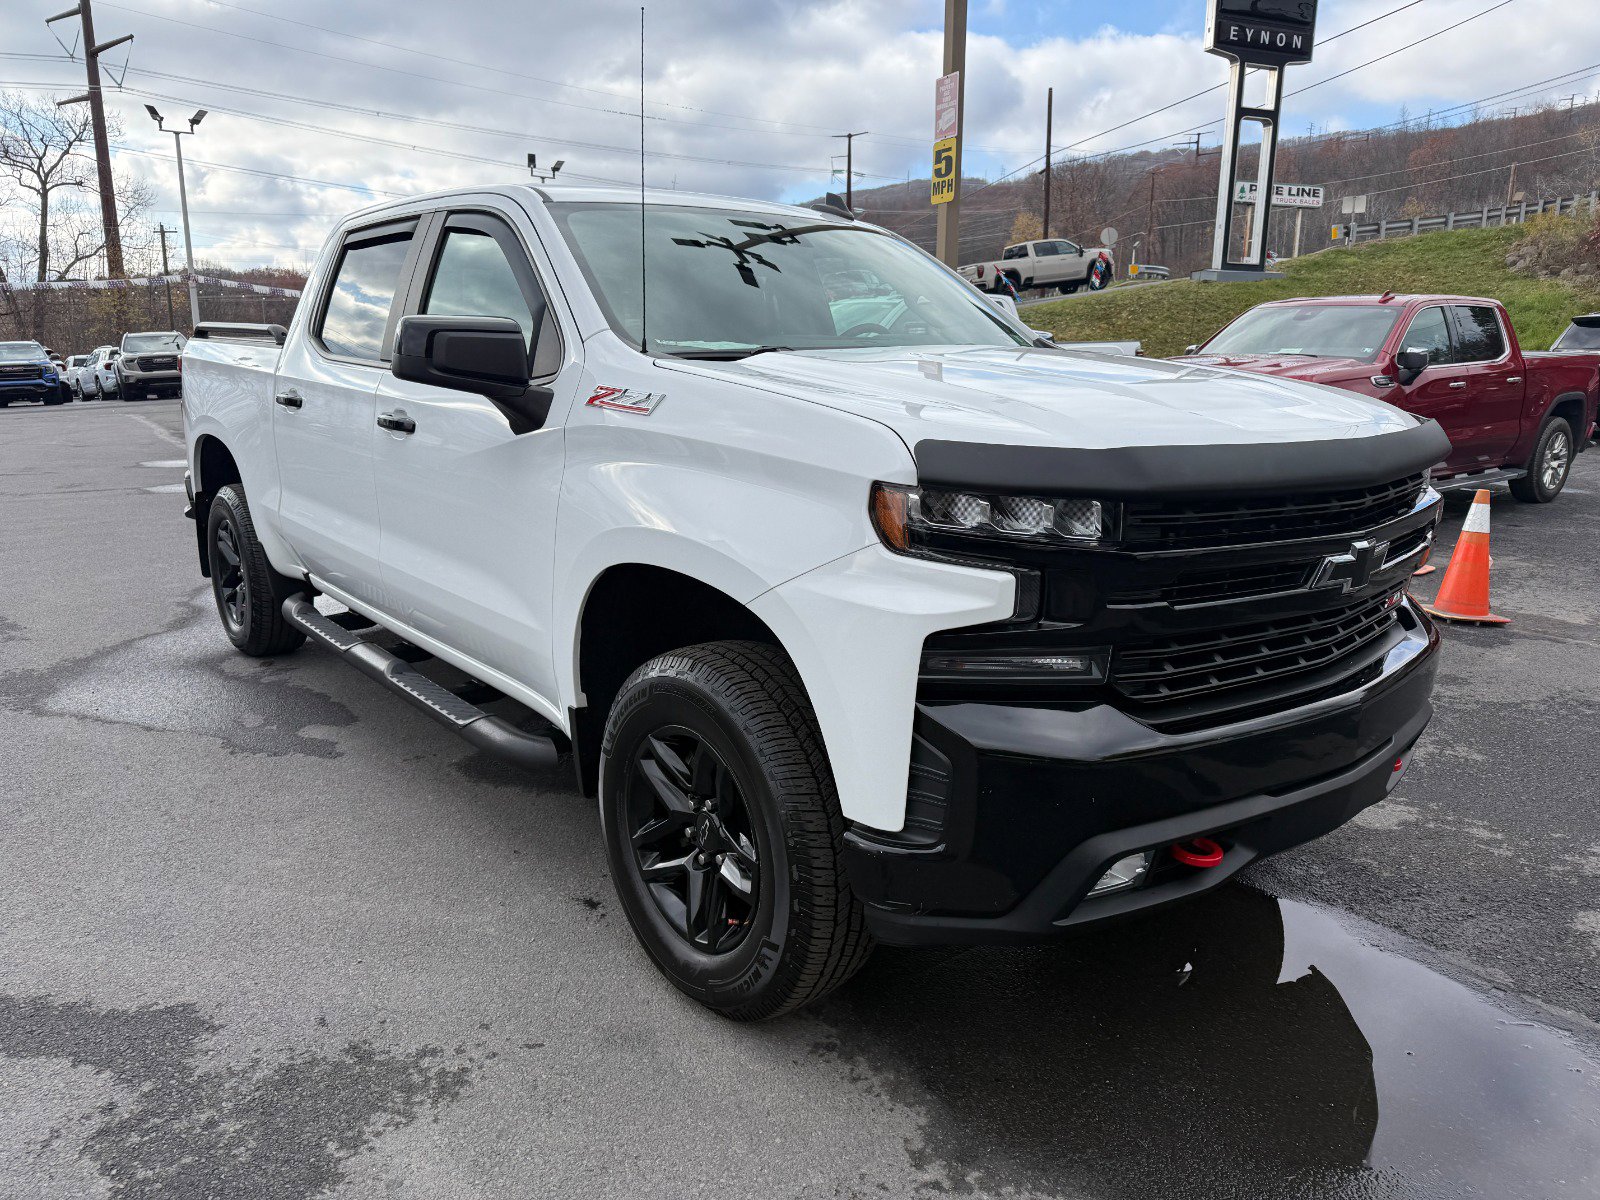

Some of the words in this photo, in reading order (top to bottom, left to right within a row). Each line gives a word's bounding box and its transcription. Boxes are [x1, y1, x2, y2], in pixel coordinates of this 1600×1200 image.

[1229, 26, 1302, 49] EYNON
[934, 147, 953, 179] 5
[932, 179, 954, 197] MPH
[1249, 184, 1284, 196] PE
[1287, 187, 1320, 198] LINE
[610, 686, 649, 731] MICHELIN
